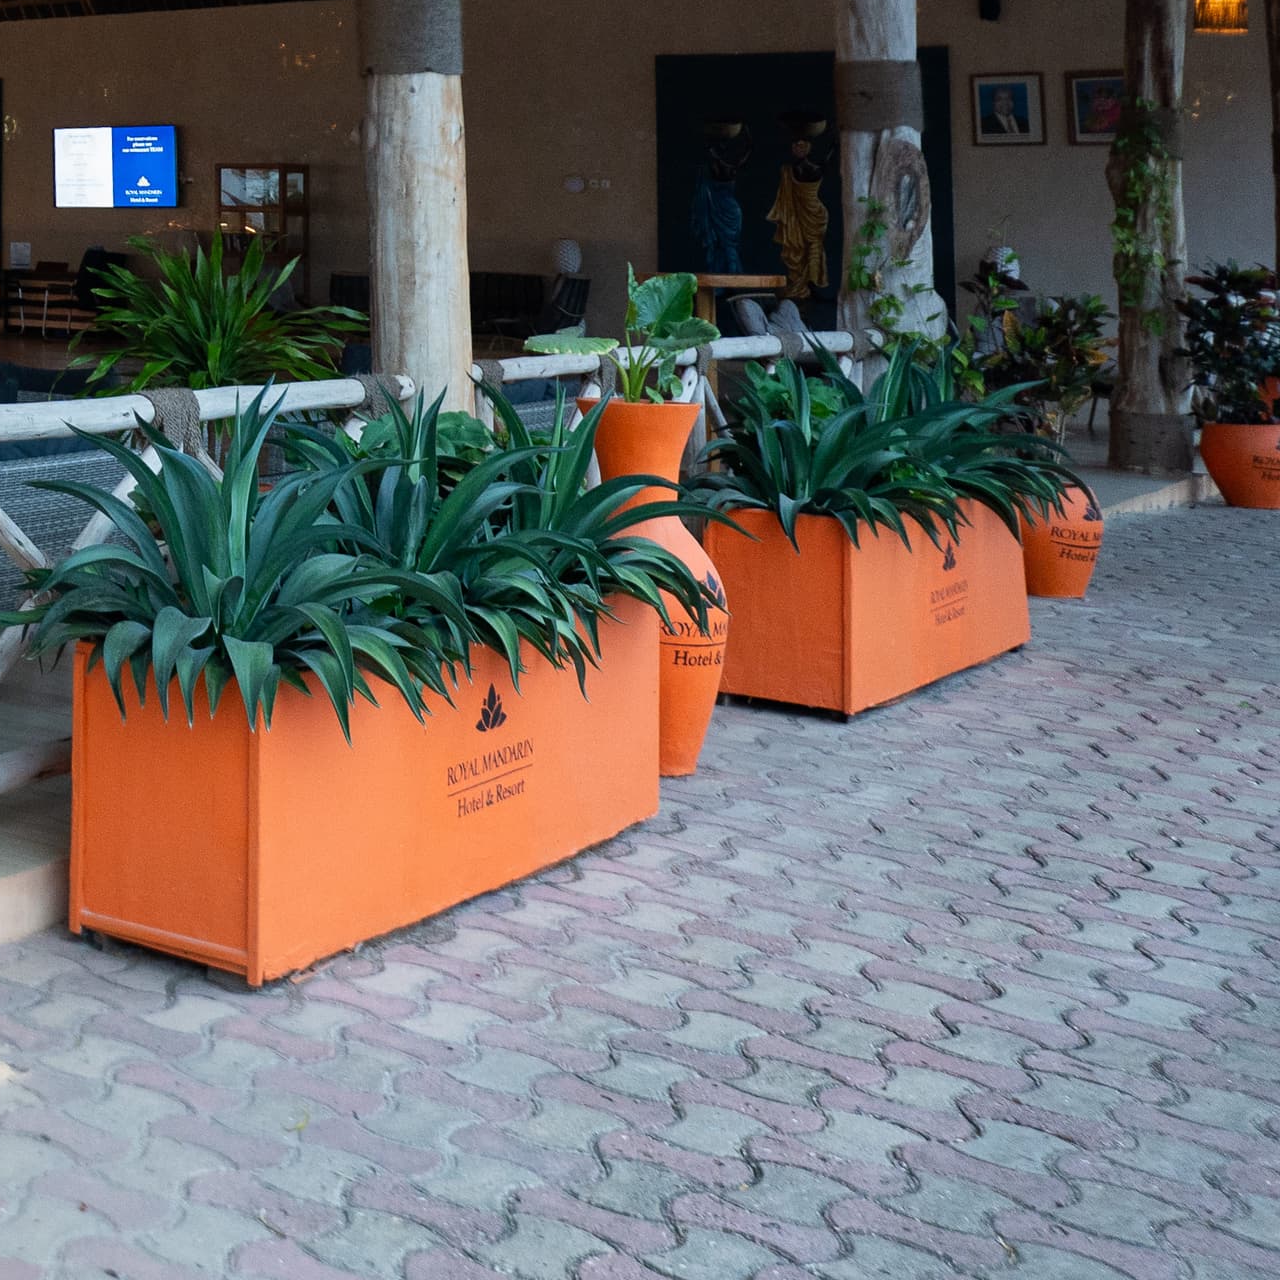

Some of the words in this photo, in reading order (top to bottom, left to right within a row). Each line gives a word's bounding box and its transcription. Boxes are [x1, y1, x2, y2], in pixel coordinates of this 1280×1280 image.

[1050, 526, 1089, 541] ROYAL
[1059, 548, 1089, 562] Hotel
[673, 649, 712, 666] Hotel
[447, 758, 480, 786] ROYAL
[482, 738, 534, 773] MANDARIN
[457, 791, 484, 818] Hotel
[486, 789, 494, 807] &
[496, 779, 525, 803] Resort
